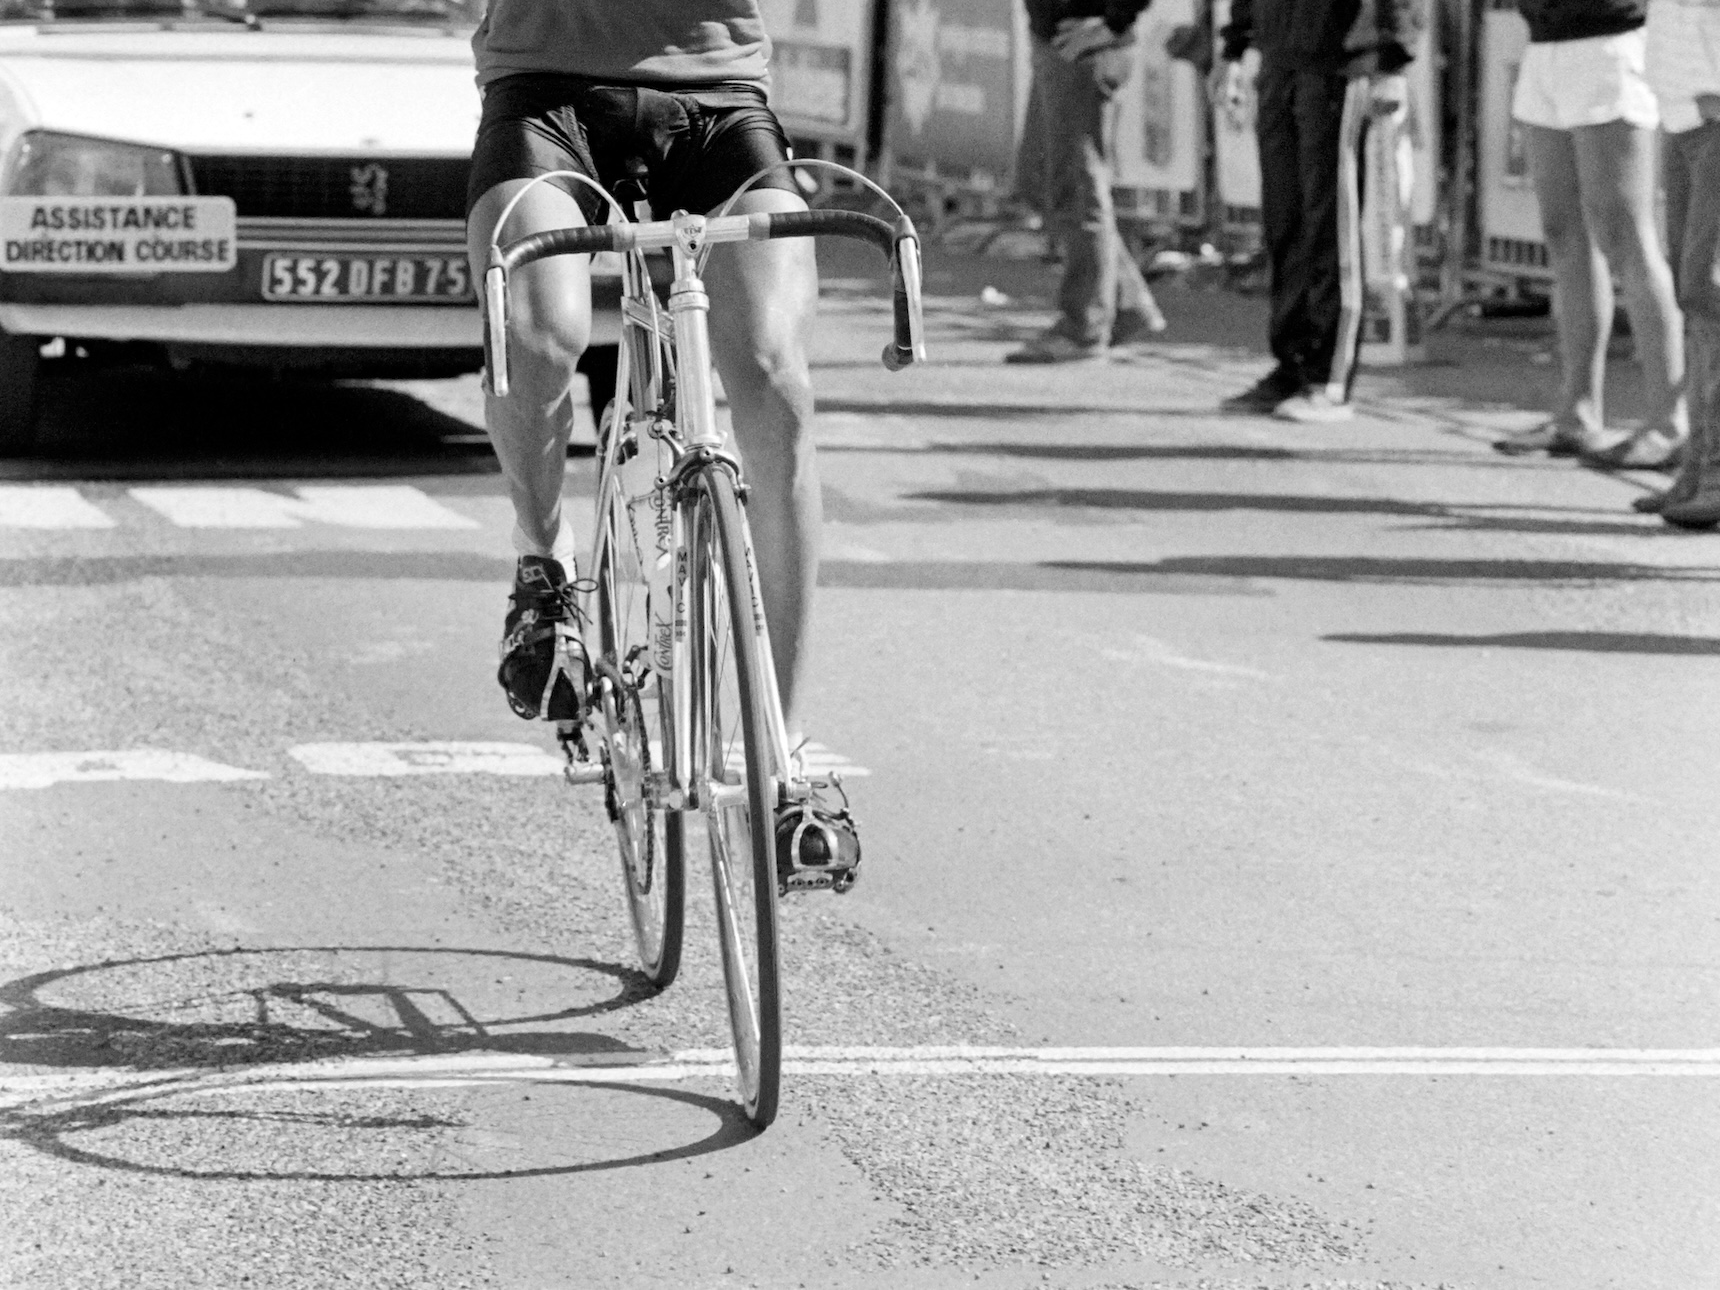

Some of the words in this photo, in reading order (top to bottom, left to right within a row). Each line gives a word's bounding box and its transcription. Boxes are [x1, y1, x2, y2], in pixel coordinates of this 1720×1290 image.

[31, 206, 196, 230] ASSISTANCE
[6, 240, 125, 262] DIRECTION
[135, 240, 230, 262] COURSE
[273, 259, 341, 296] 552
[424, 259, 467, 295] 75
[677, 550, 688, 614] MAVIC
